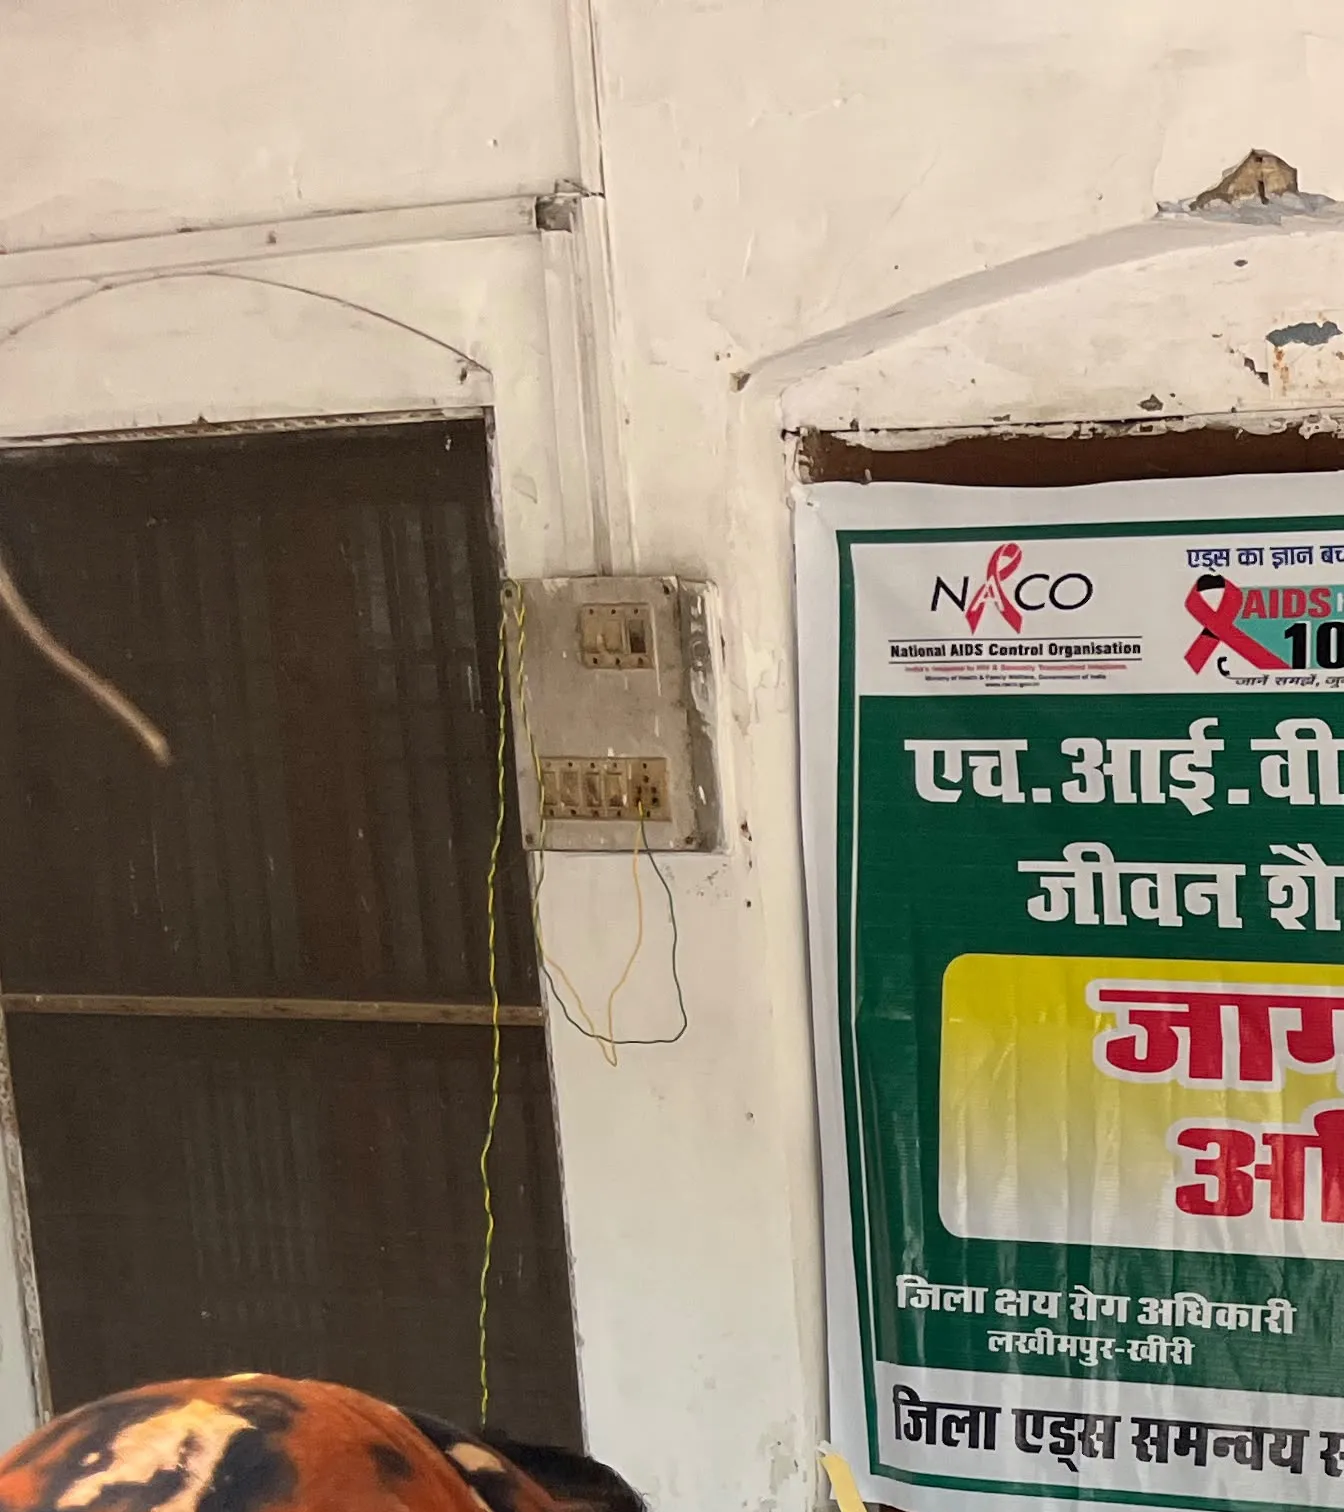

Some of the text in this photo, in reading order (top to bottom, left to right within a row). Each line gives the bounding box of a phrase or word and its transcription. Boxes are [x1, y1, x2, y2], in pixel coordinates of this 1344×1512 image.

[1187, 549, 1230, 572] एड्स
[1236, 547, 1264, 566] का
[1270, 545, 1314, 569] ज्ञान
[930, 572, 1094, 612] NACO
[1241, 587, 1332, 619] AIDS
[890, 641, 1141, 658] National AIDS Control Organisation
[1017, 841, 1247, 929] जीवन
[896, 1274, 1298, 1336] जिला क्षय रोग अधिकारी
[986, 1328, 1195, 1368] लखीमपुर-खीरी
[892, 1384, 1001, 1451] जिला
[1010, 1406, 1122, 1473] एड्स
[1131, 1416, 1309, 1476] समन्वय
